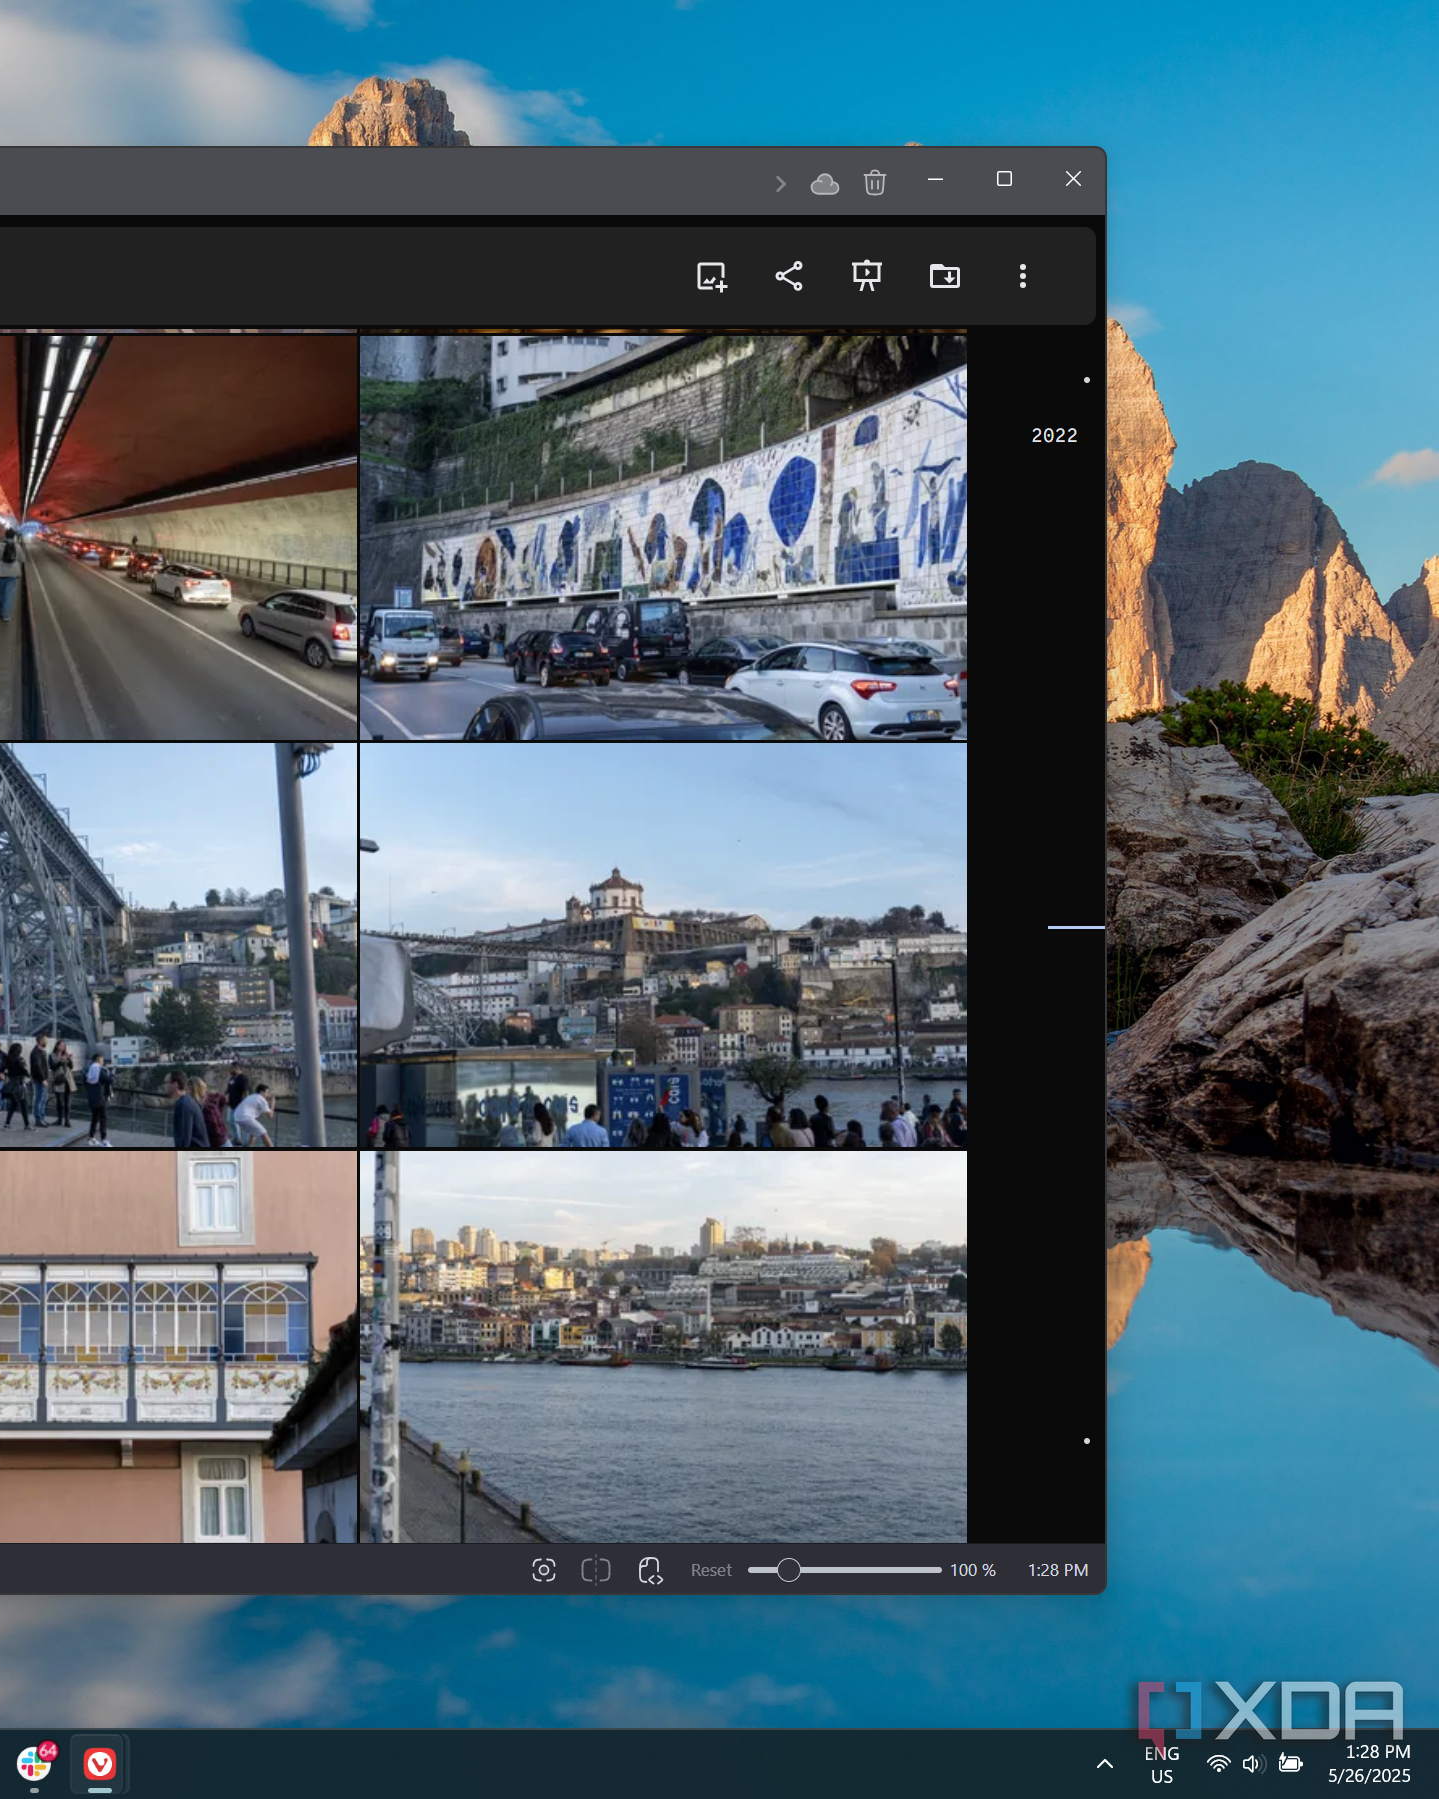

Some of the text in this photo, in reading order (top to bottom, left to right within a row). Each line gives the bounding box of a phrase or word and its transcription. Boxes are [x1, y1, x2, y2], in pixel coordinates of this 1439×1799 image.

[1032, 427, 1078, 443] 2022
[691, 1563, 733, 1577] Reset
[950, 1563, 997, 1577] 100 %
[1028, 1563, 1089, 1577] 1:28 PM
[39, 1743, 58, 1758] 64
[1145, 1746, 1180, 1761] ENG
[1346, 1744, 1411, 1759] 1:28 PM
[1151, 1769, 1174, 1784] US
[1328, 1768, 1411, 1785] 5/26/2025
